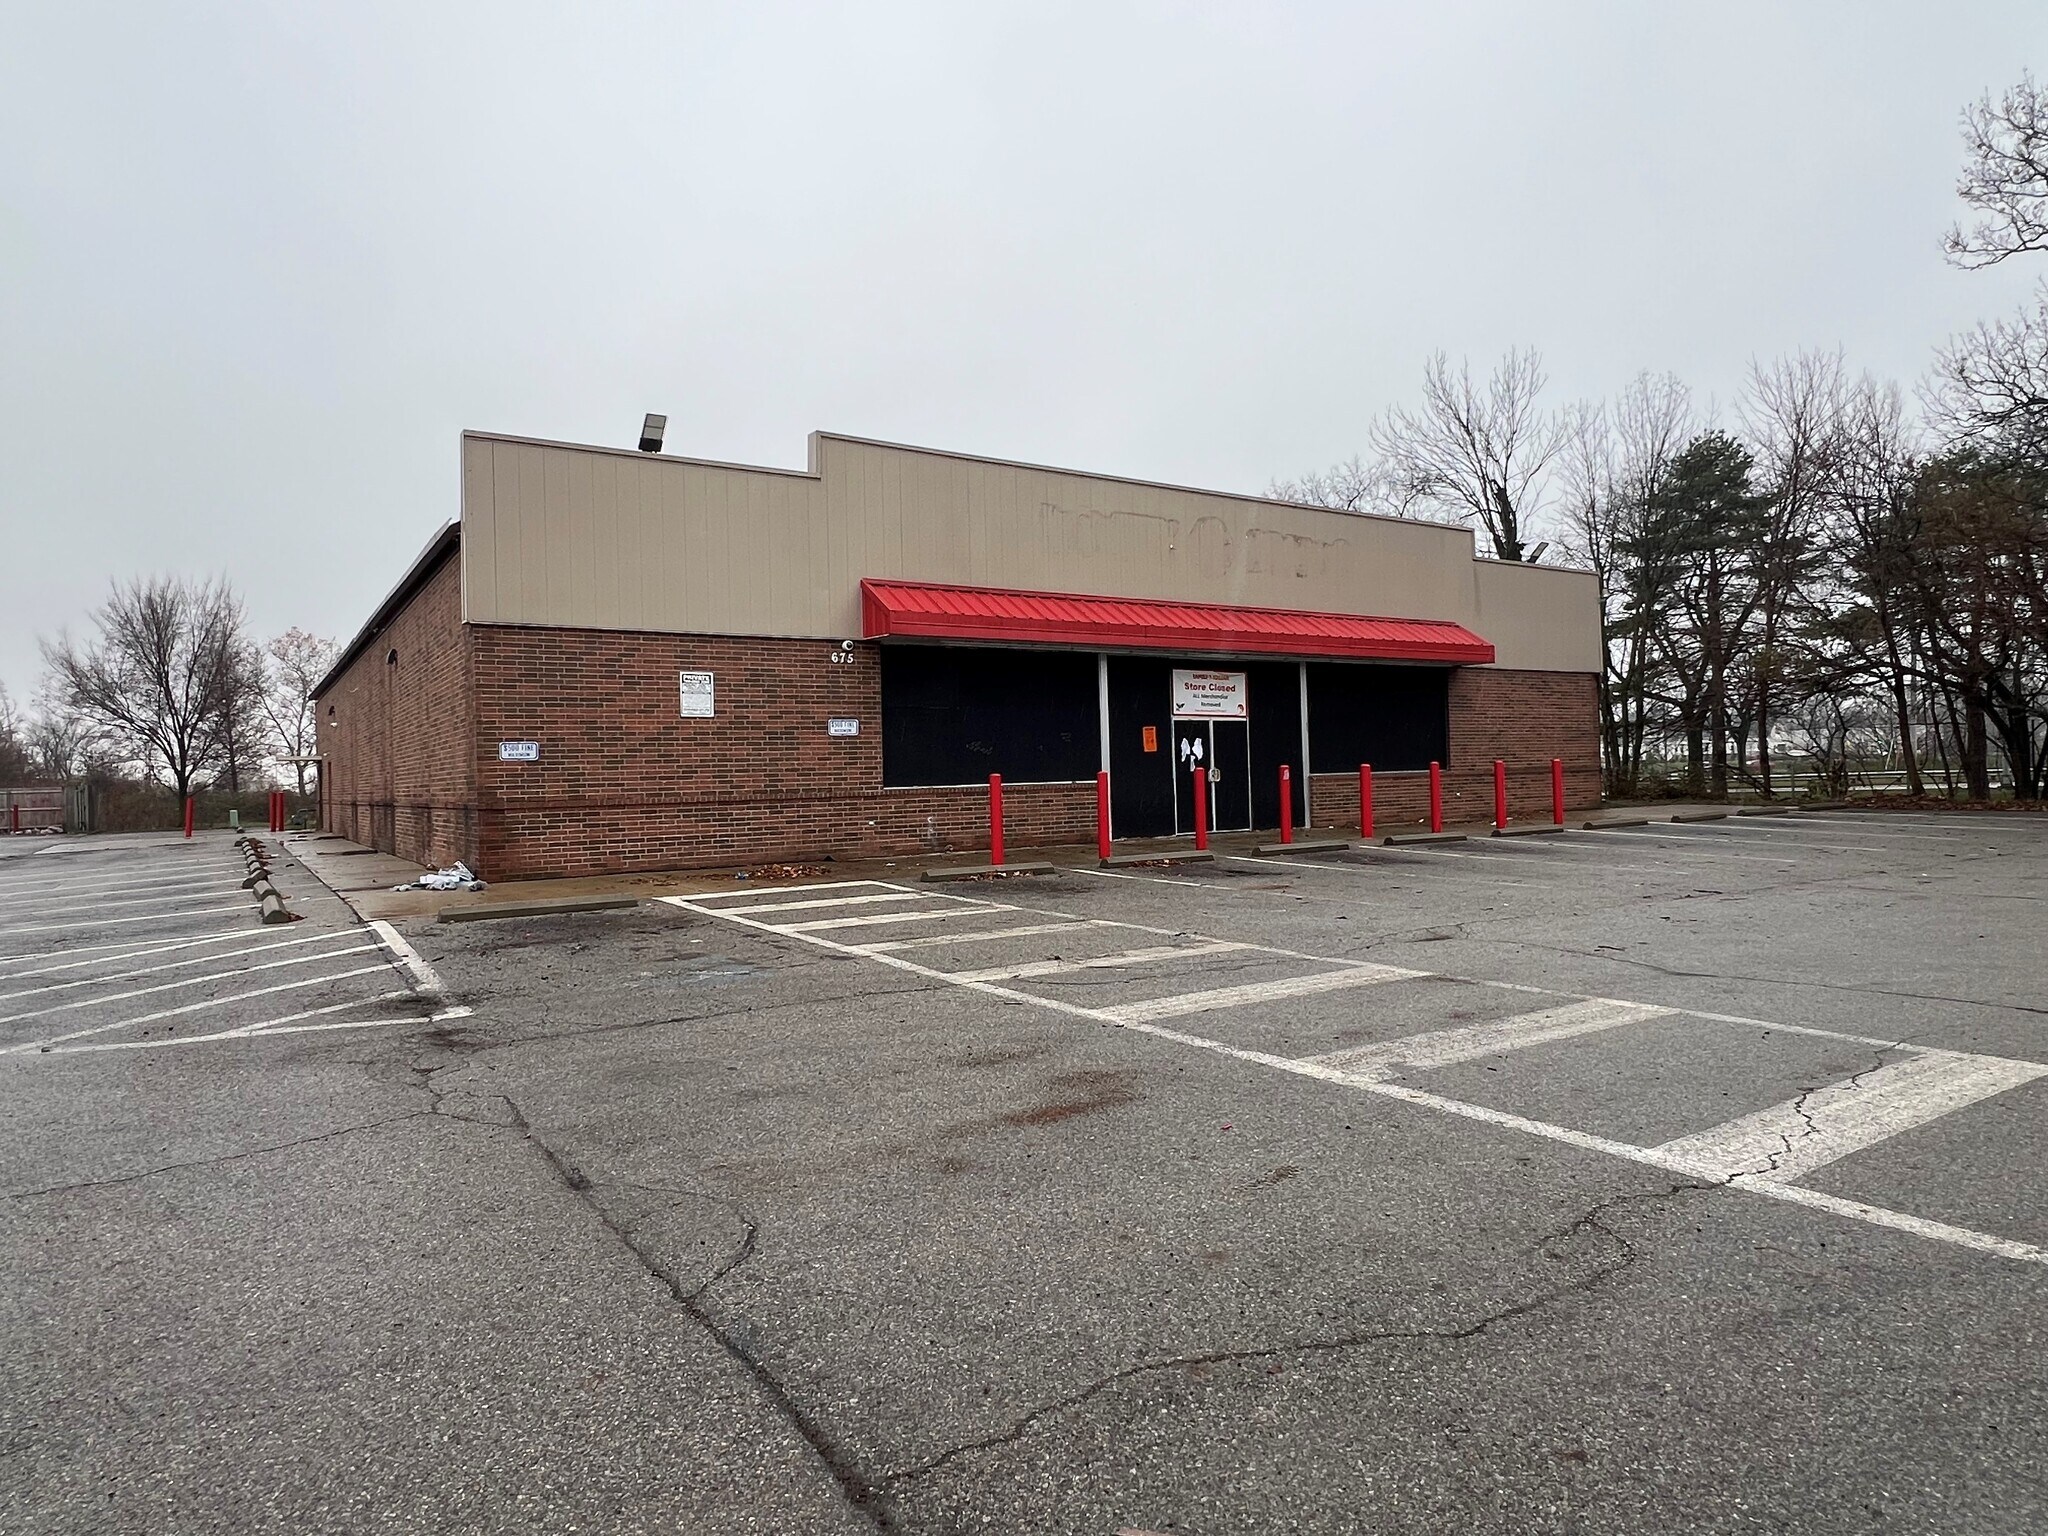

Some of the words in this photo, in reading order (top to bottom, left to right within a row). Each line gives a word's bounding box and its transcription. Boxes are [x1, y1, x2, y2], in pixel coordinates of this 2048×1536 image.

[831, 652, 854, 664] 675
[1184, 682, 1206, 691] Store
[1208, 683, 1236, 692] Closed
